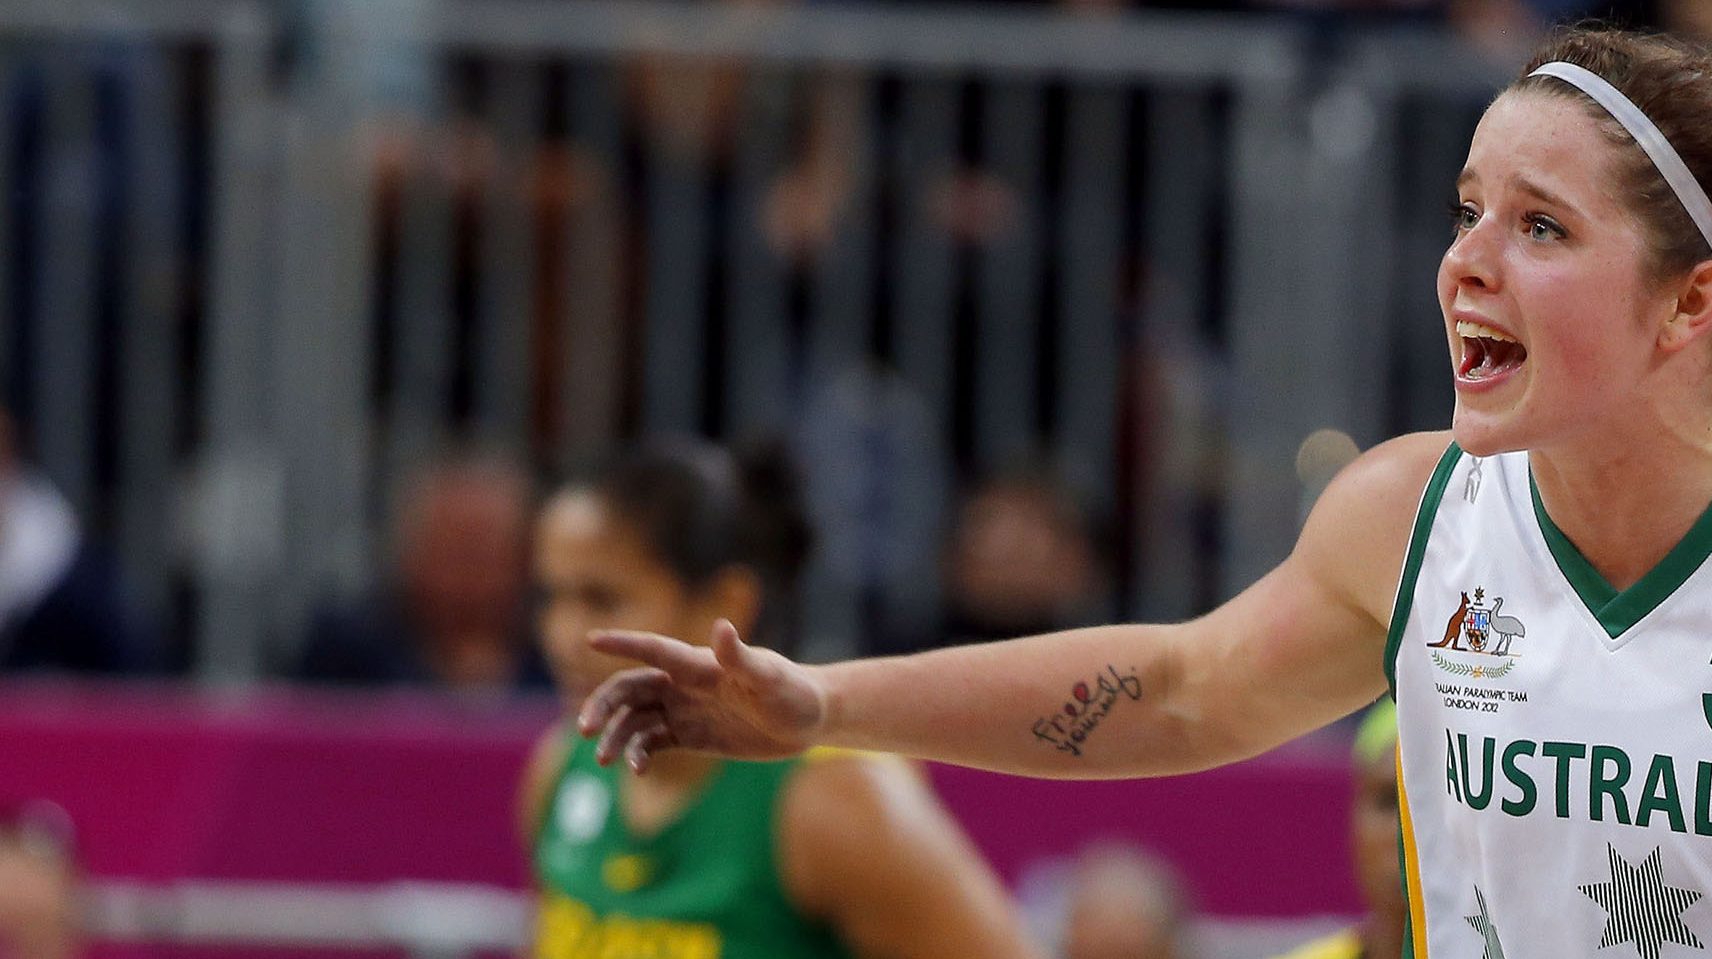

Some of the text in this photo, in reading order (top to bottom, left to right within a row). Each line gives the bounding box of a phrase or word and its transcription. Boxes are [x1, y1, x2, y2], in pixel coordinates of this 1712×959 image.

[1463, 686, 1506, 701] PARALYMPIC
[1507, 690, 1528, 703] TEAM
[1443, 696, 1499, 713] LONDON 2012
